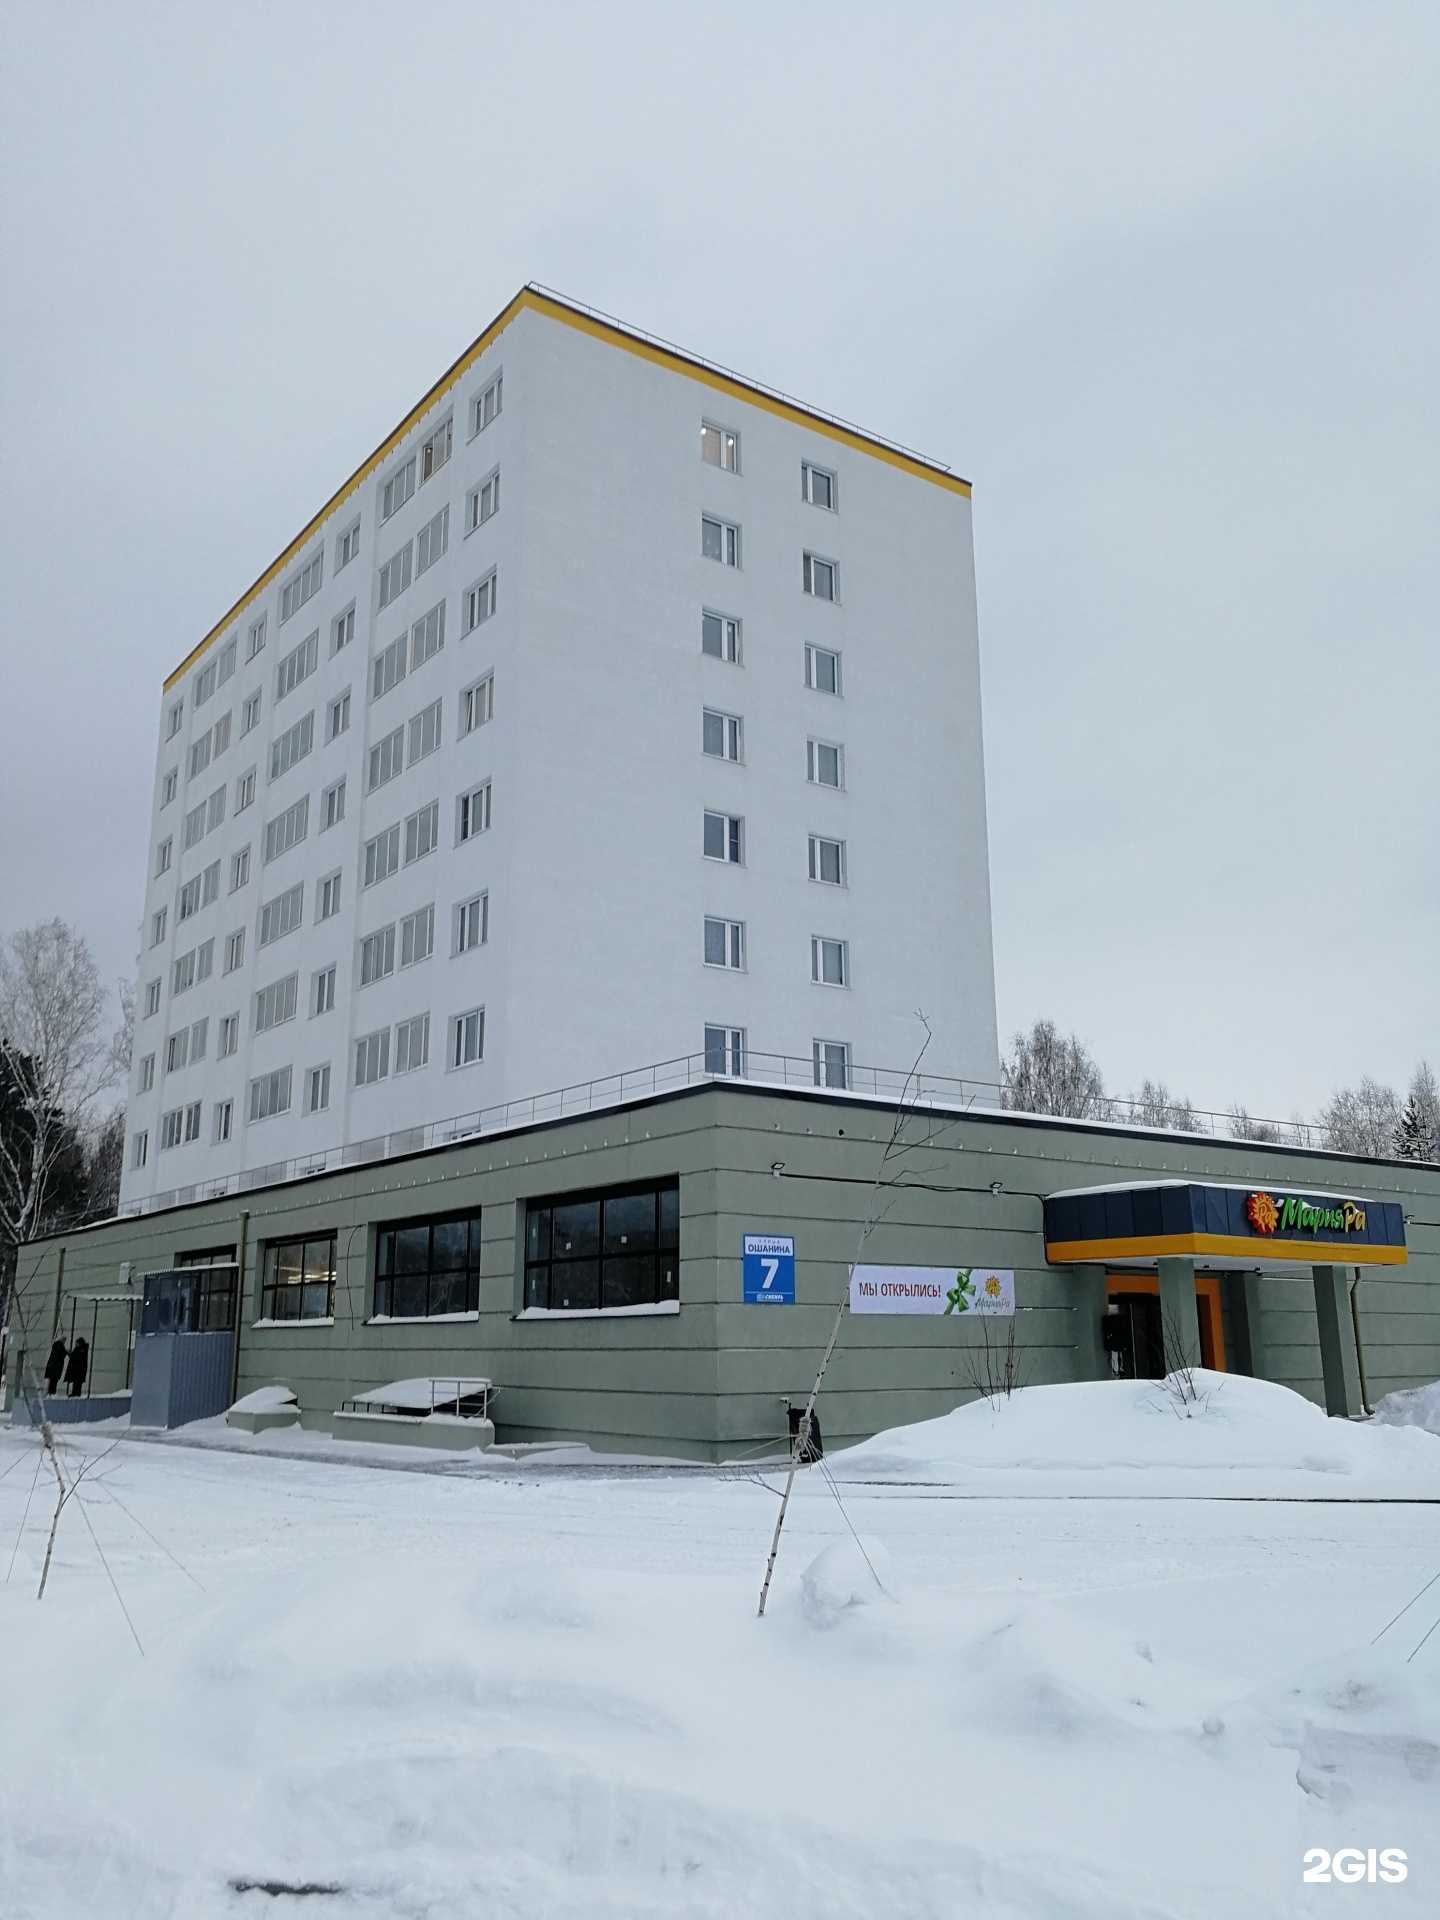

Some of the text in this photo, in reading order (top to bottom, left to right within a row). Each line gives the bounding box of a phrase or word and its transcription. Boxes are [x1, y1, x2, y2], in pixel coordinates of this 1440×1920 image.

[748, 1244, 791, 1254] ОШАНИНА
[760, 1258, 779, 1289] 7
[859, 1282, 941, 1298] МЫ ОТКРЫЛИСЬ!
